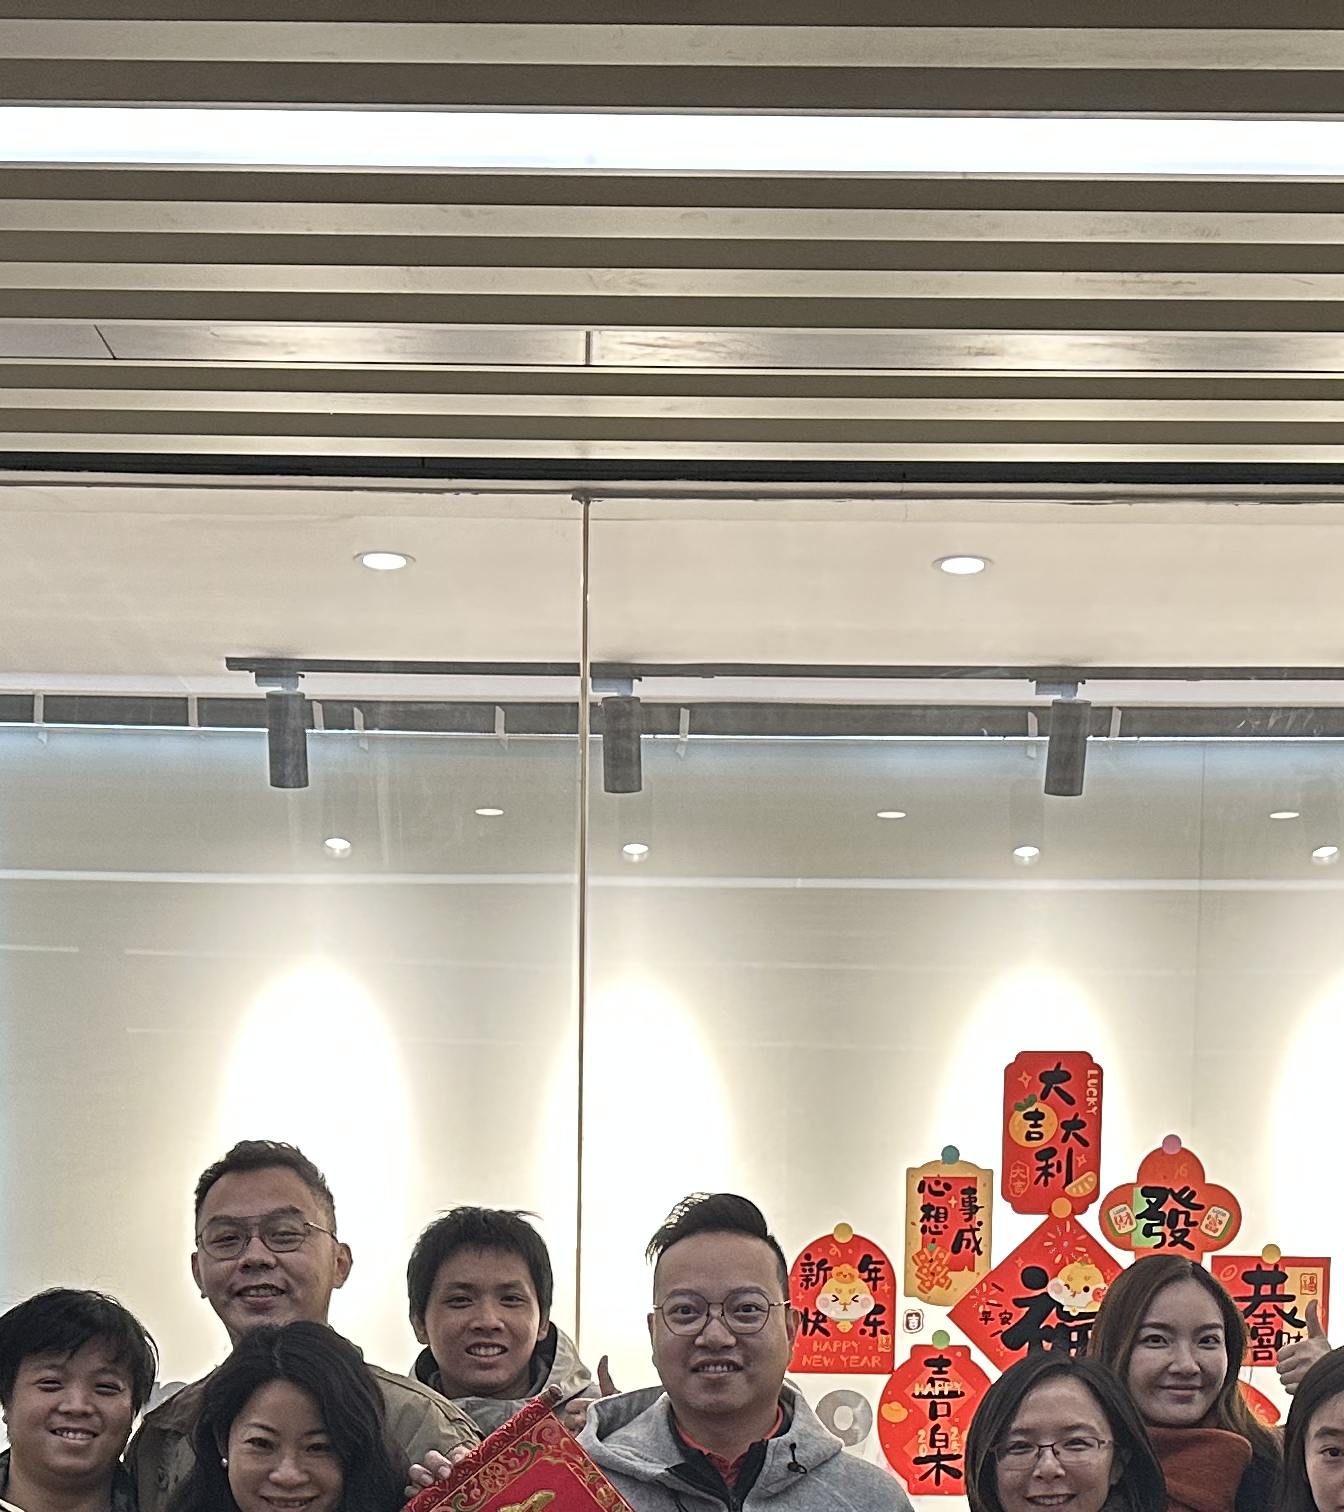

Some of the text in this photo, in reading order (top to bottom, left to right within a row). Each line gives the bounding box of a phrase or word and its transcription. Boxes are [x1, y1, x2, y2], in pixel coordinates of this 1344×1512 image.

[1085, 1069, 1099, 1116] LUCKY
[1135, 1186, 1205, 1251] 發
[800, 1253, 885, 1291] 新年
[801, 1305, 889, 1337] 快乐
[802, 1355, 882, 1368] NEW YEAR
[813, 1340, 860, 1353] HAPPY
[913, 1380, 963, 1396] HAPPY
